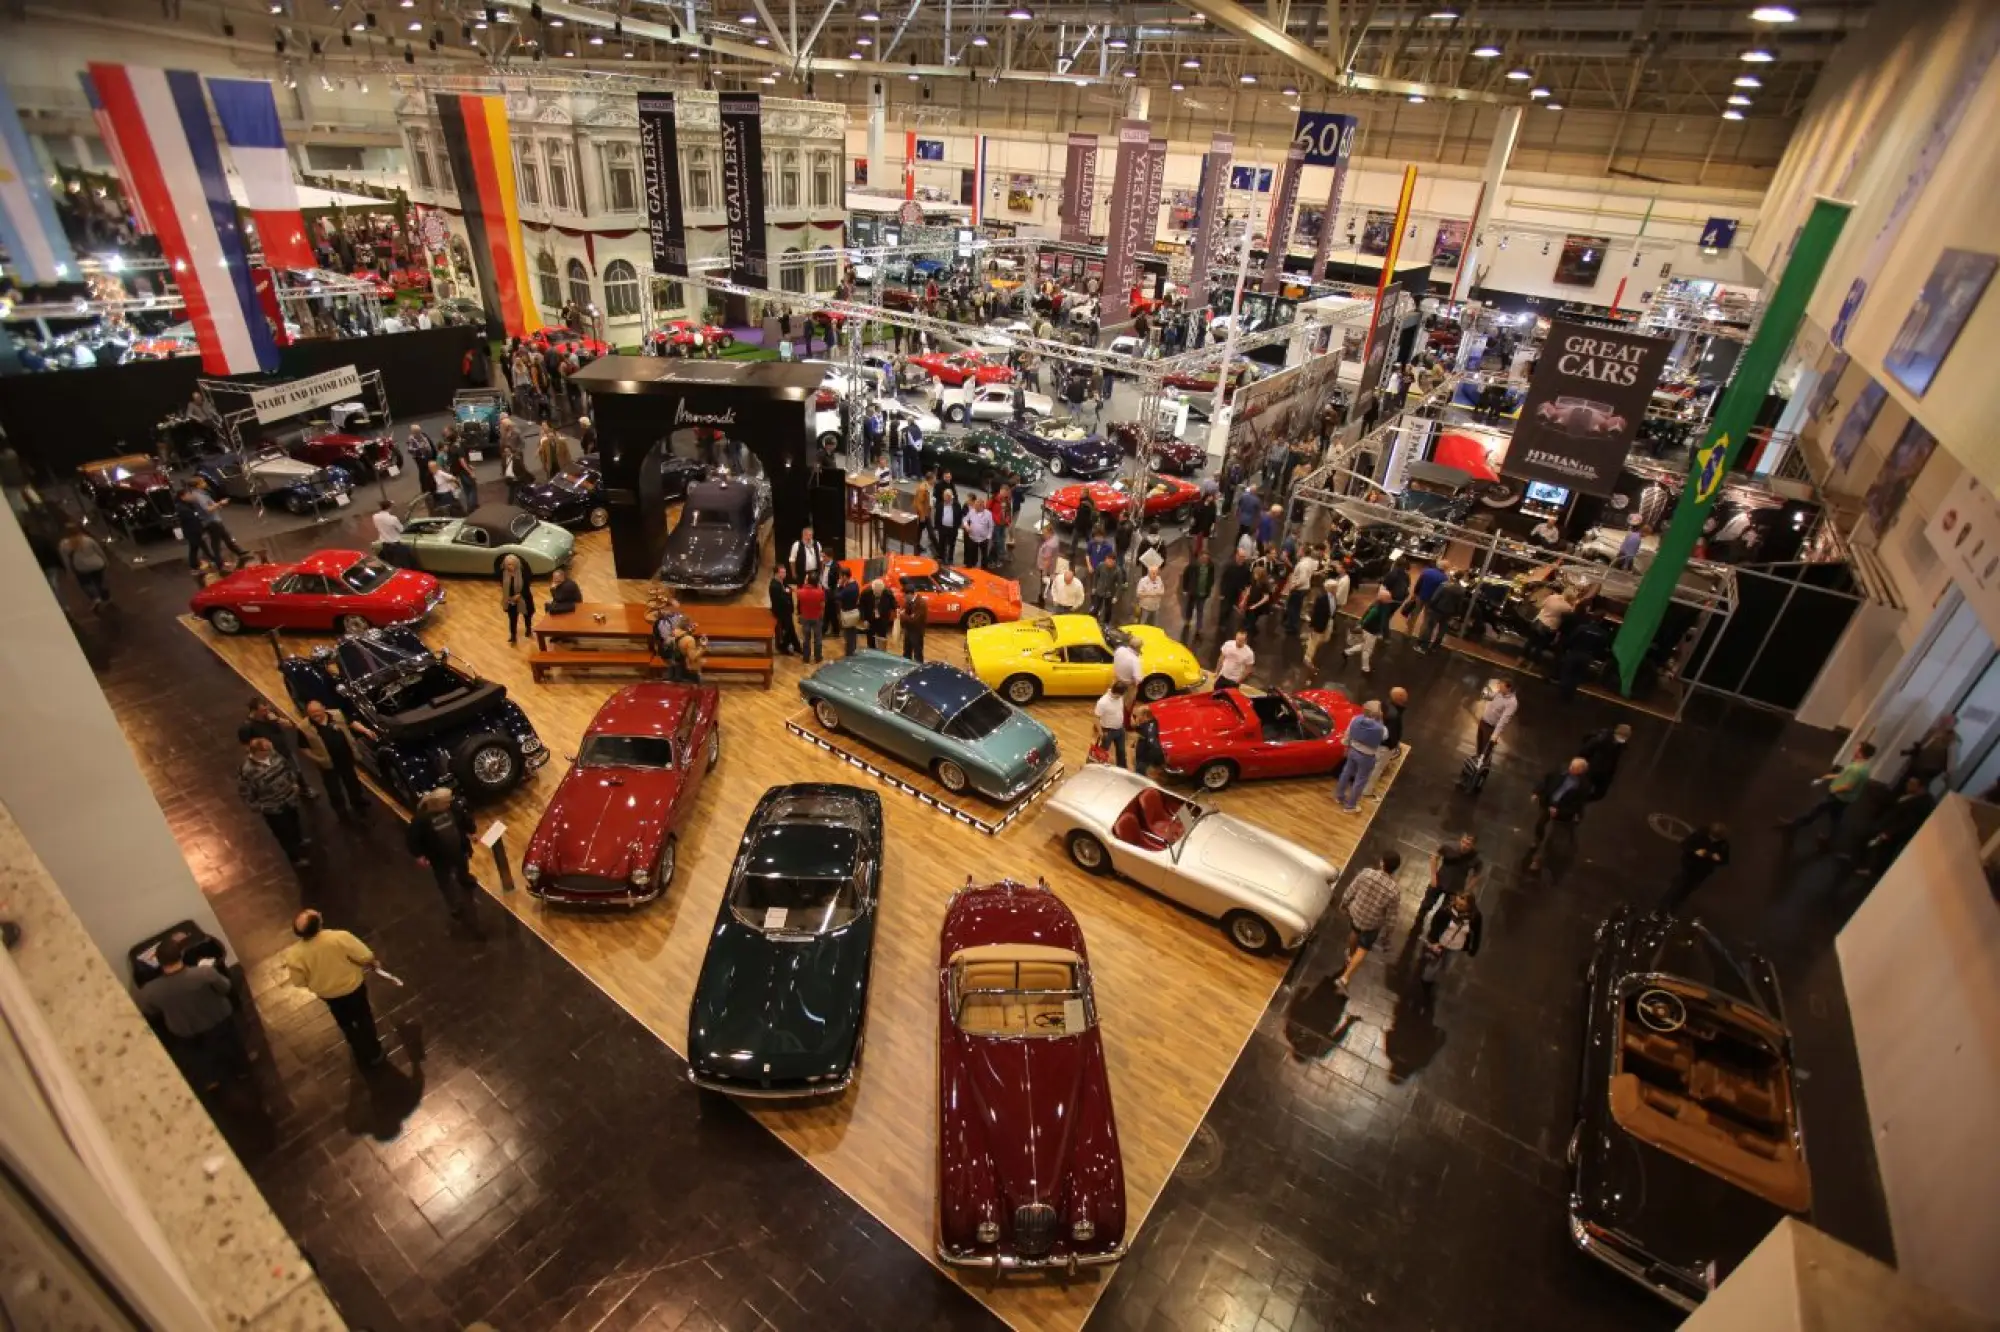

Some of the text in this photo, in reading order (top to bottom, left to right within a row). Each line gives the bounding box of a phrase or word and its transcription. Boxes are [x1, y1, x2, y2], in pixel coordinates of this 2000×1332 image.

[641, 118, 661, 213] GALLERY
[723, 122, 741, 222] GALLERY
[652, 220, 665, 259] THE
[731, 229, 744, 270] THE
[1704, 228, 1718, 246] 4
[1565, 336, 1648, 365] GREAT
[1558, 354, 1639, 386] CARS
[256, 394, 287, 410] START
[1528, 449, 1580, 469] HYMAN
